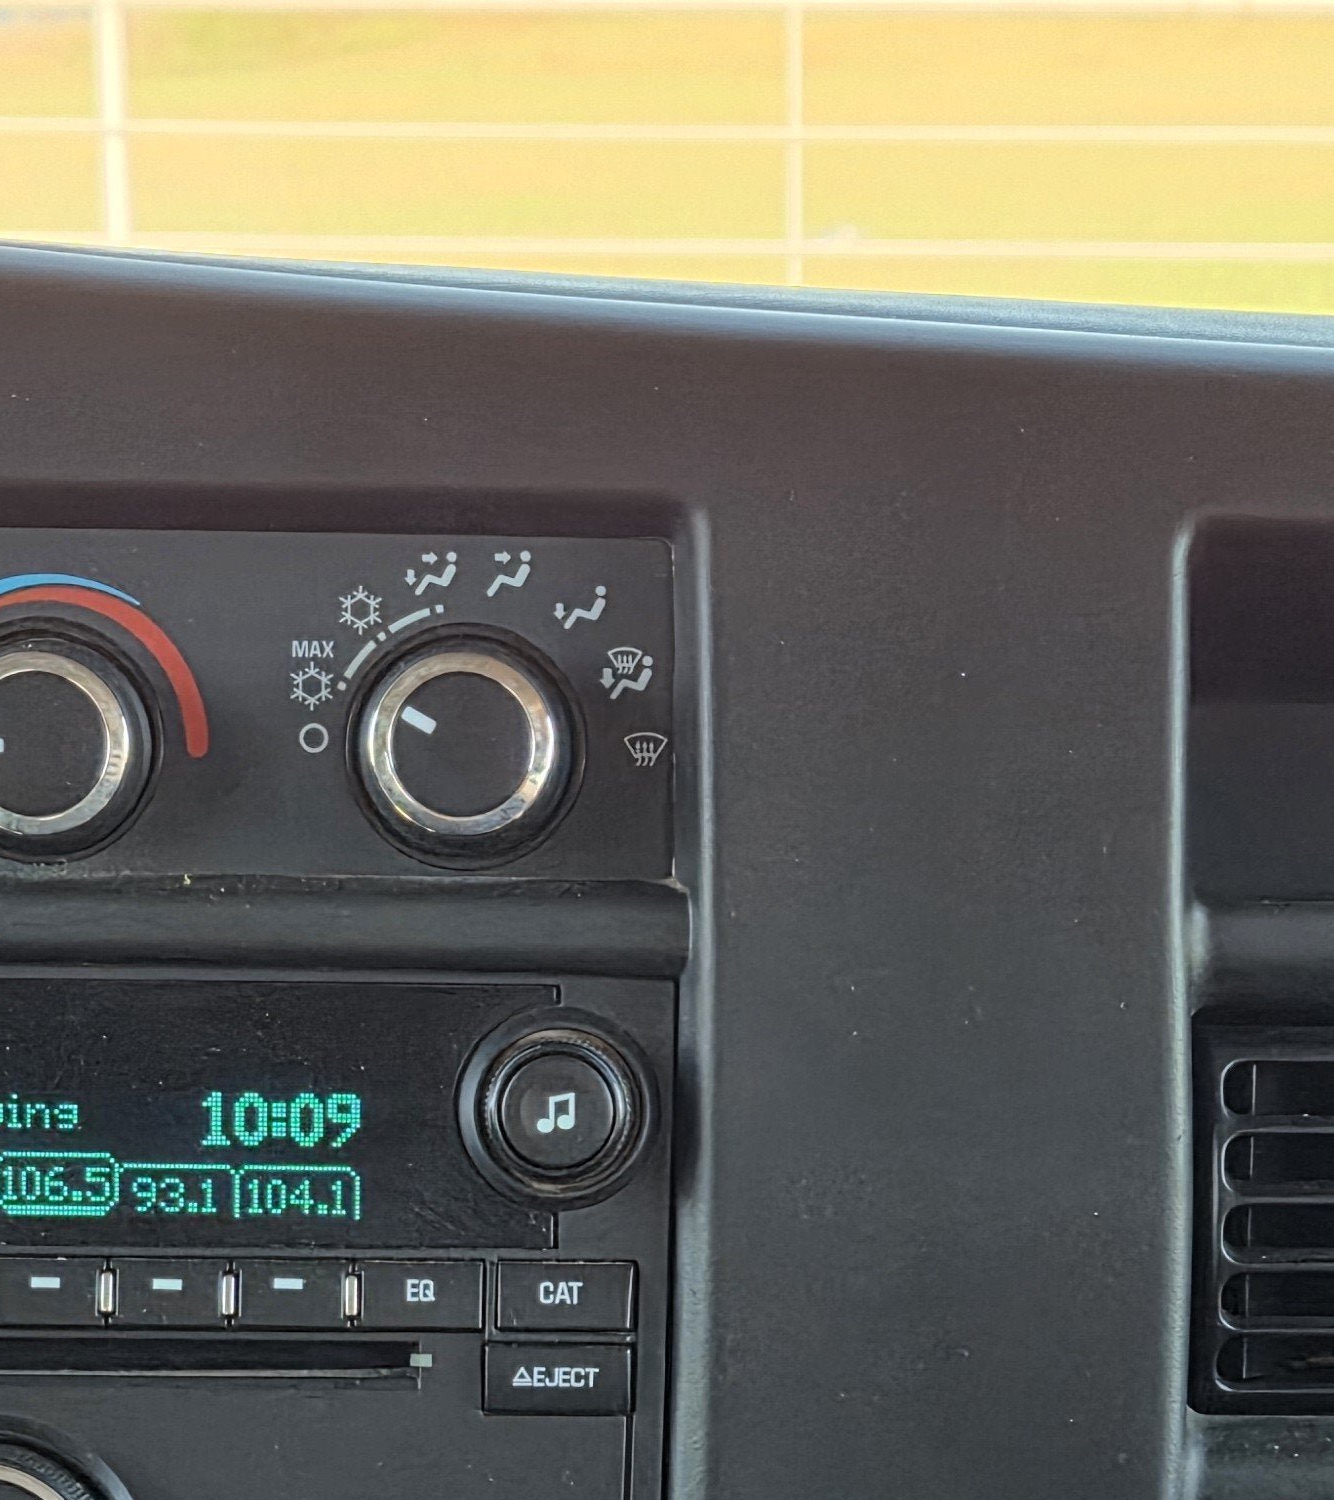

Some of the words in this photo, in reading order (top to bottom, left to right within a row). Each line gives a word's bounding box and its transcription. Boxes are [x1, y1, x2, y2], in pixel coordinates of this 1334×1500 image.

[291, 640, 334, 658] MAX
[201, 1091, 361, 1148] 10:09
[1, 1164, 111, 1202] 106.5
[131, 1177, 218, 1214] 93.1
[247, 1178, 348, 1216] 104.1
[406, 1278, 436, 1302] EQ
[539, 1281, 584, 1305] CAT
[533, 1366, 600, 1388] EJECT
